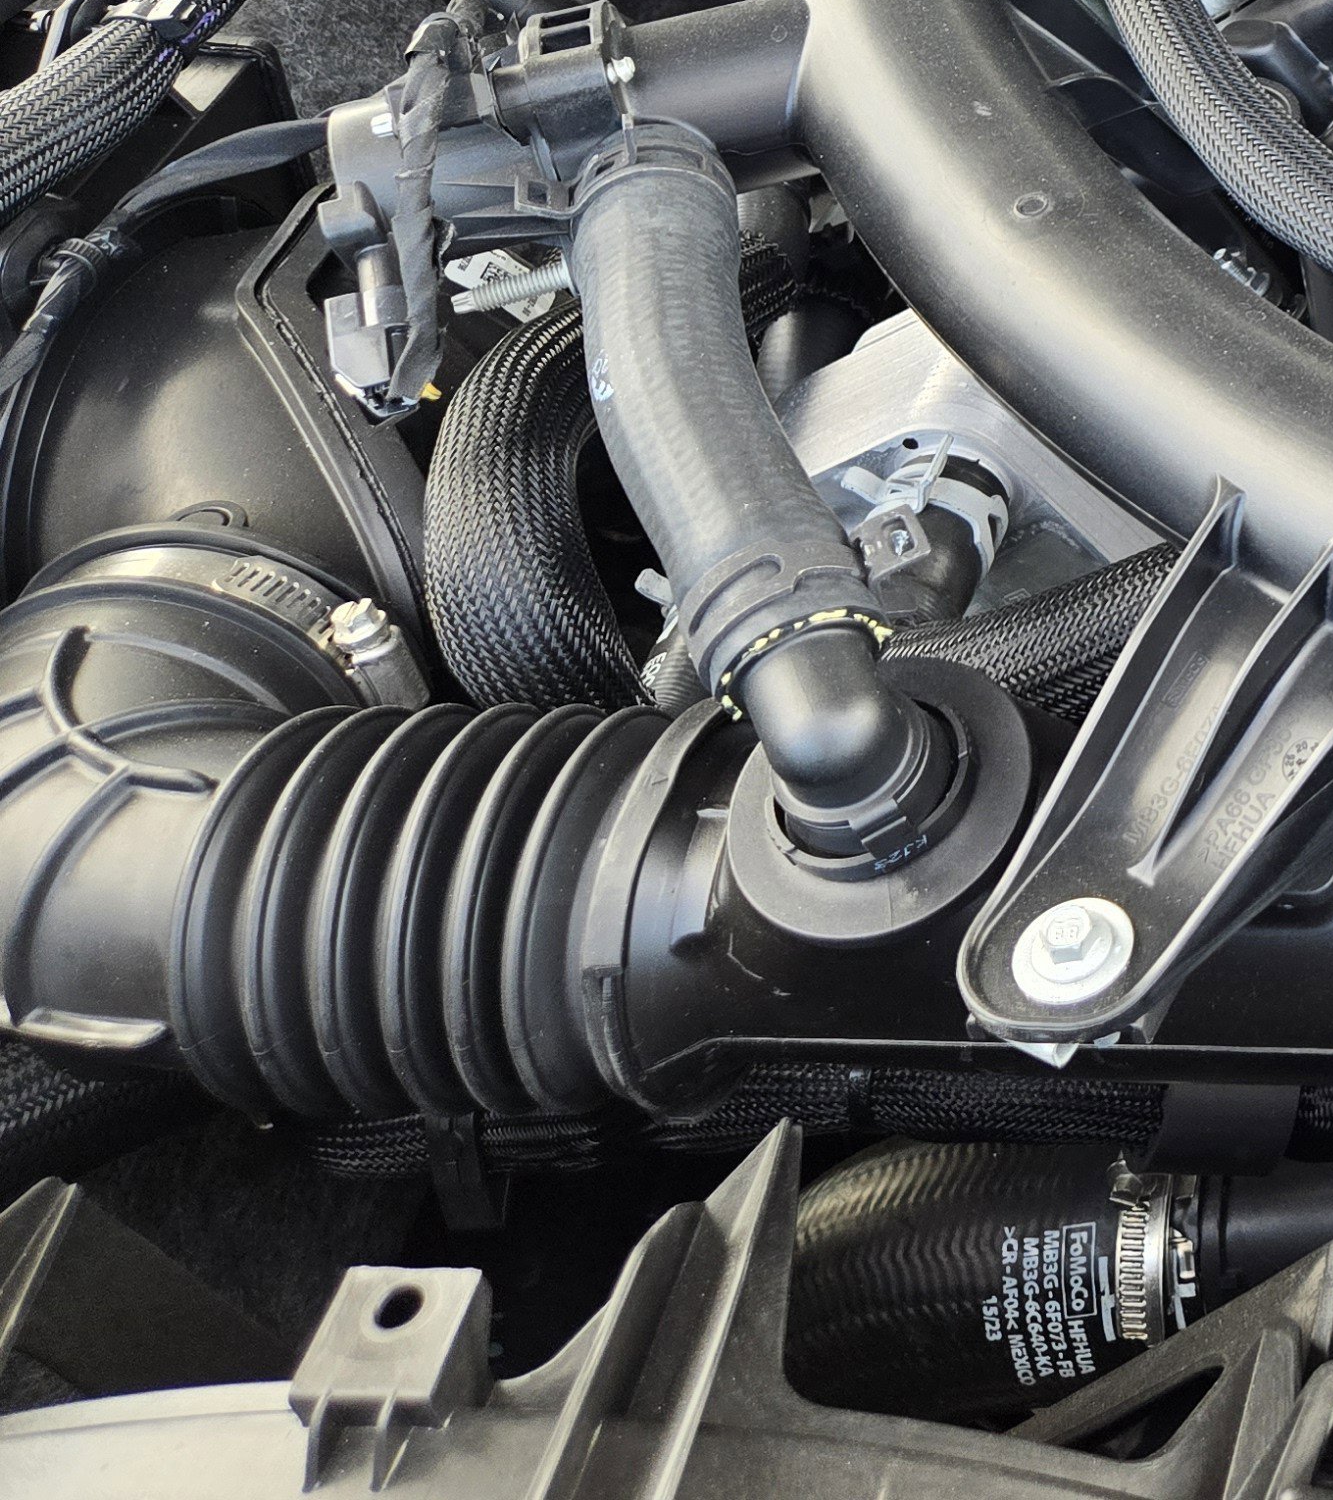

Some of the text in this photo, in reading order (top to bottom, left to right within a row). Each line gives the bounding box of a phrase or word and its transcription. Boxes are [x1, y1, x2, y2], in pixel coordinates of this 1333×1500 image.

[982, 1295, 1003, 1342] 15/23
[1067, 1230, 1096, 1375] FoMoCo HFHUA
[1007, 1334, 1037, 1386] MEXICO
